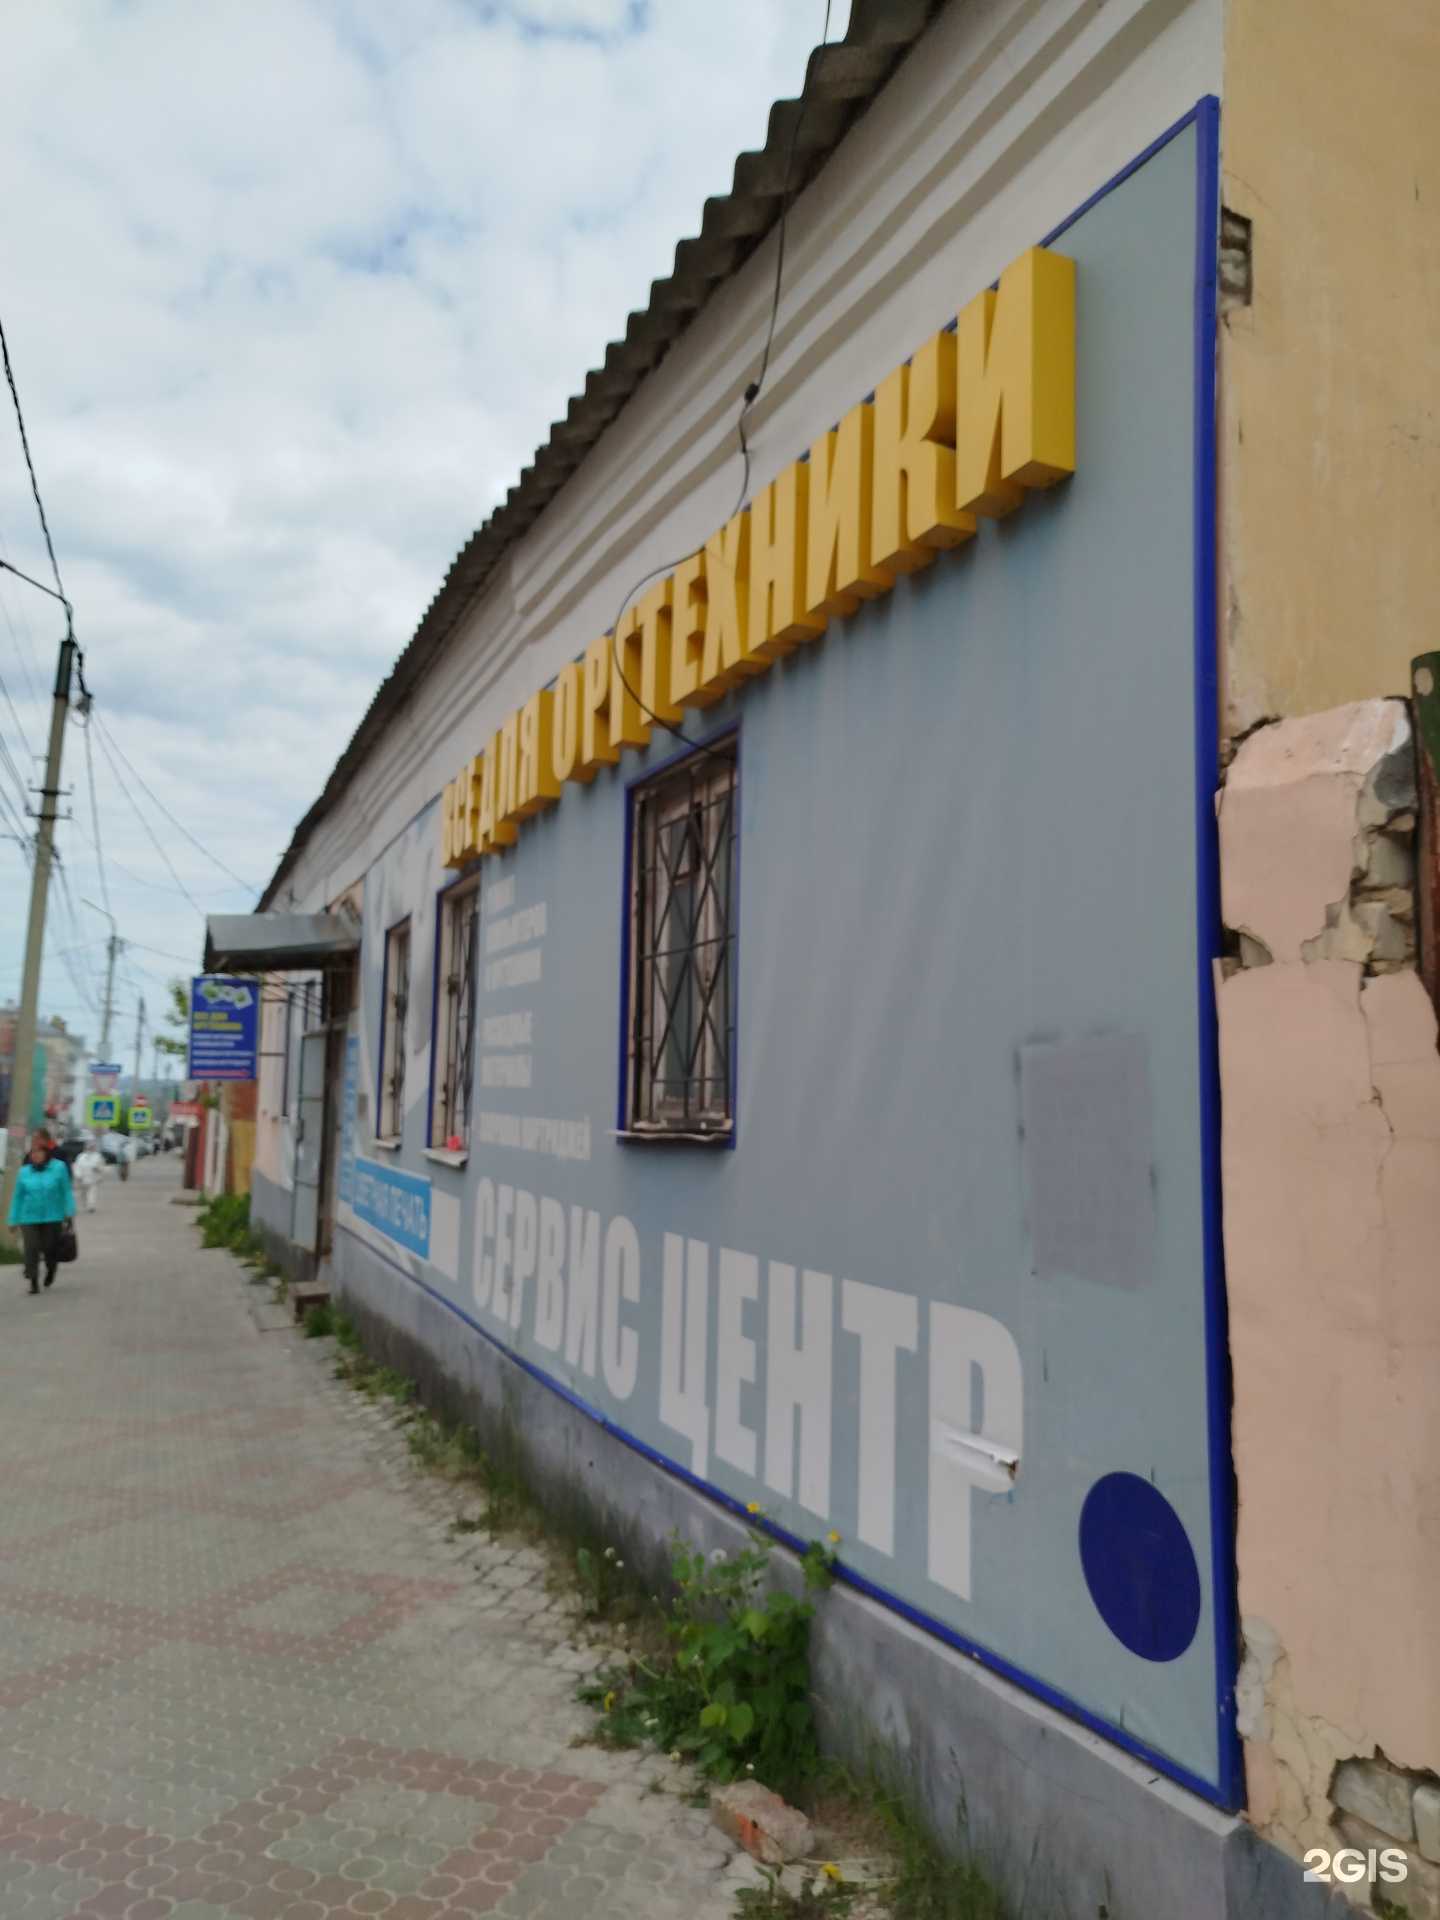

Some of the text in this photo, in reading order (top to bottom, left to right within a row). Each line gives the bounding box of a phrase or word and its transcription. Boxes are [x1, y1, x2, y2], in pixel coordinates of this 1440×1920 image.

[476, 688, 547, 854] ДЛЯ
[553, 245, 1074, 784] ОРГТЕХНИКИ
[472, 1176, 1024, 1602] СЕРВИС ЦЕНТР
